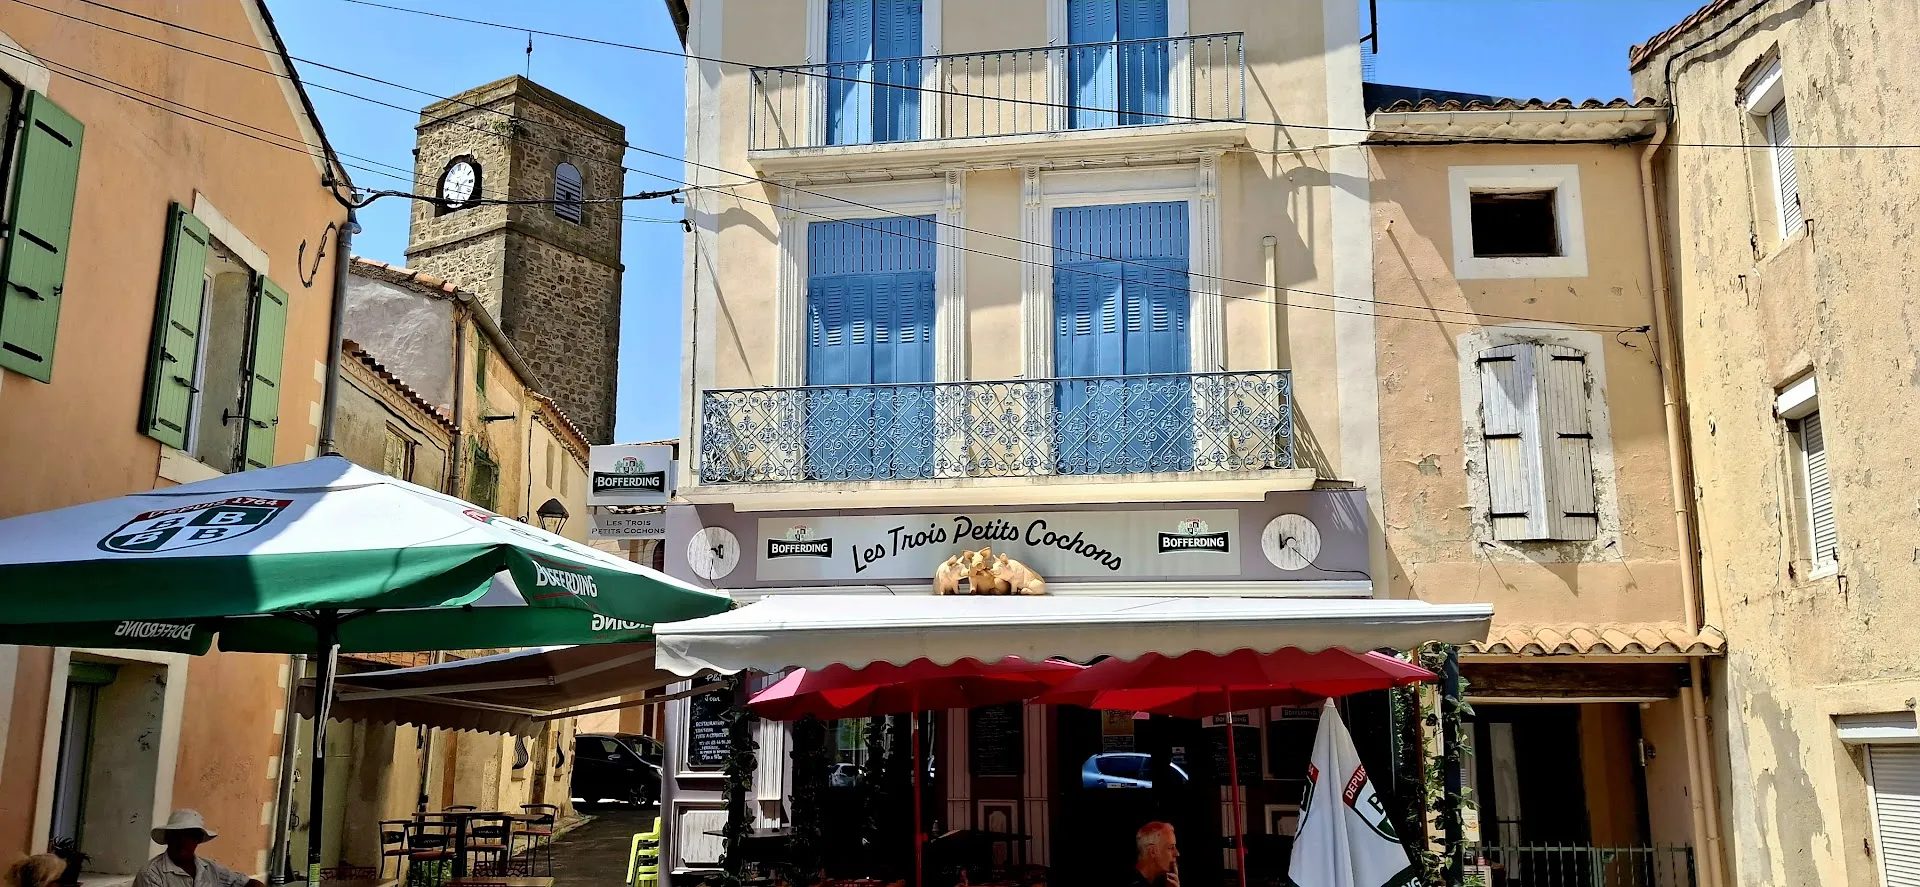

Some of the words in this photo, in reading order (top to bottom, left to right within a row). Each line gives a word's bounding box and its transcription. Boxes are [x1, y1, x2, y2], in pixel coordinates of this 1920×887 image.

[597, 476, 660, 487] BOFFERDING
[852, 543, 886, 573] Les
[887, 523, 946, 557] Trois
[953, 515, 1020, 544] Petits
[1025, 519, 1122, 571] Cochons
[1162, 537, 1225, 548] BOFFERDING
[771, 543, 829, 554] BOFFERDING
